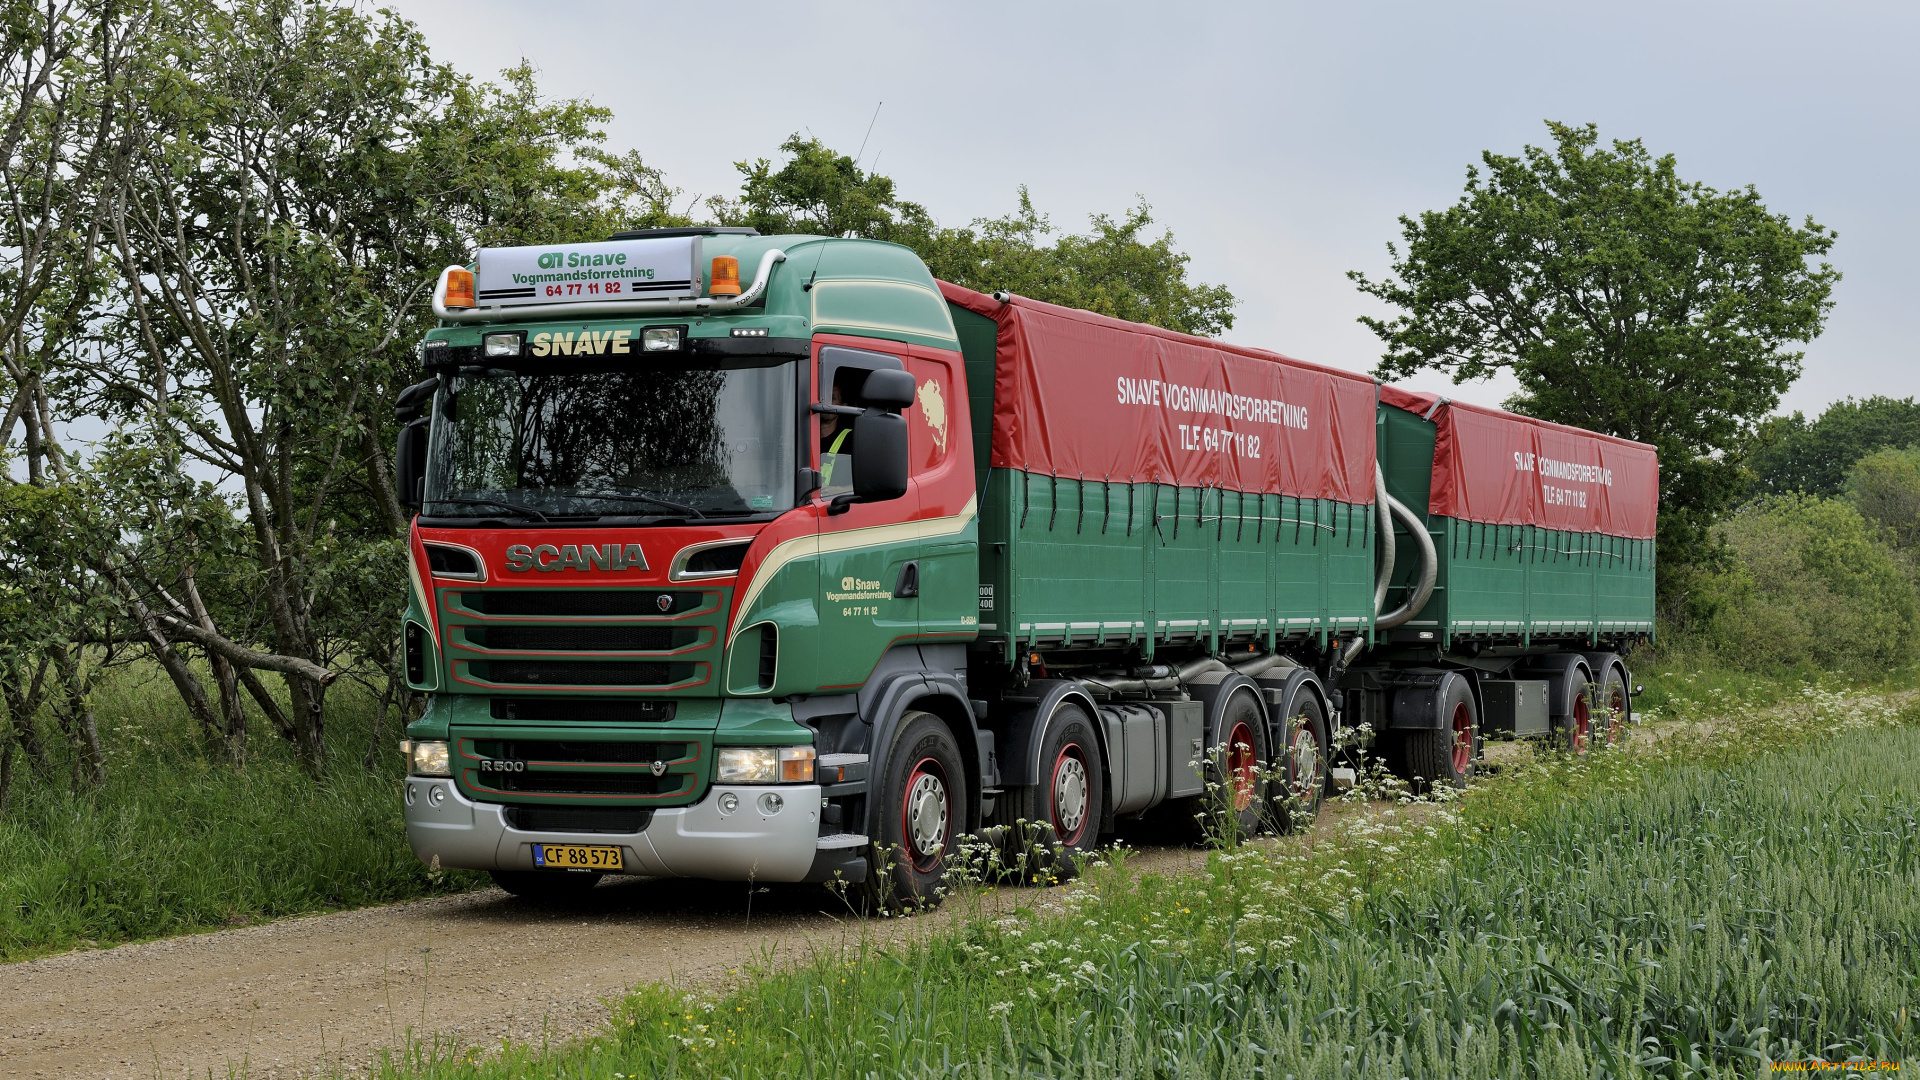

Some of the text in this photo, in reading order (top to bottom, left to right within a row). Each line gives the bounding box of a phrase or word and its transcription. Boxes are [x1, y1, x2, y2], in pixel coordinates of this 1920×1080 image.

[567, 252, 627, 268] Snave
[512, 267, 655, 286] Vognmandsforretning
[545, 281, 622, 297] 64 77 11 82
[532, 330, 632, 357] SNAVE
[1117, 376, 1308, 430] SNAVE VOGNMANDSFORRETNING
[1203, 427, 1219, 453] 64
[1220, 429, 1234, 454] 77
[1235, 432, 1245, 457] 11
[1247, 435, 1261, 459] 82
[1556, 488, 1564, 506] 64
[1564, 489, 1572, 506] 77
[1572, 490, 1578, 507] 11
[1579, 491, 1587, 509] 82
[505, 544, 650, 572] SCANIA
[855, 578, 881, 591] Snave
[826, 590, 892, 602] Vognmandsforretning
[978, 599, 993, 608] 400
[842, 605, 878, 616] 64 77 11 82
[545, 848, 563, 863] CF
